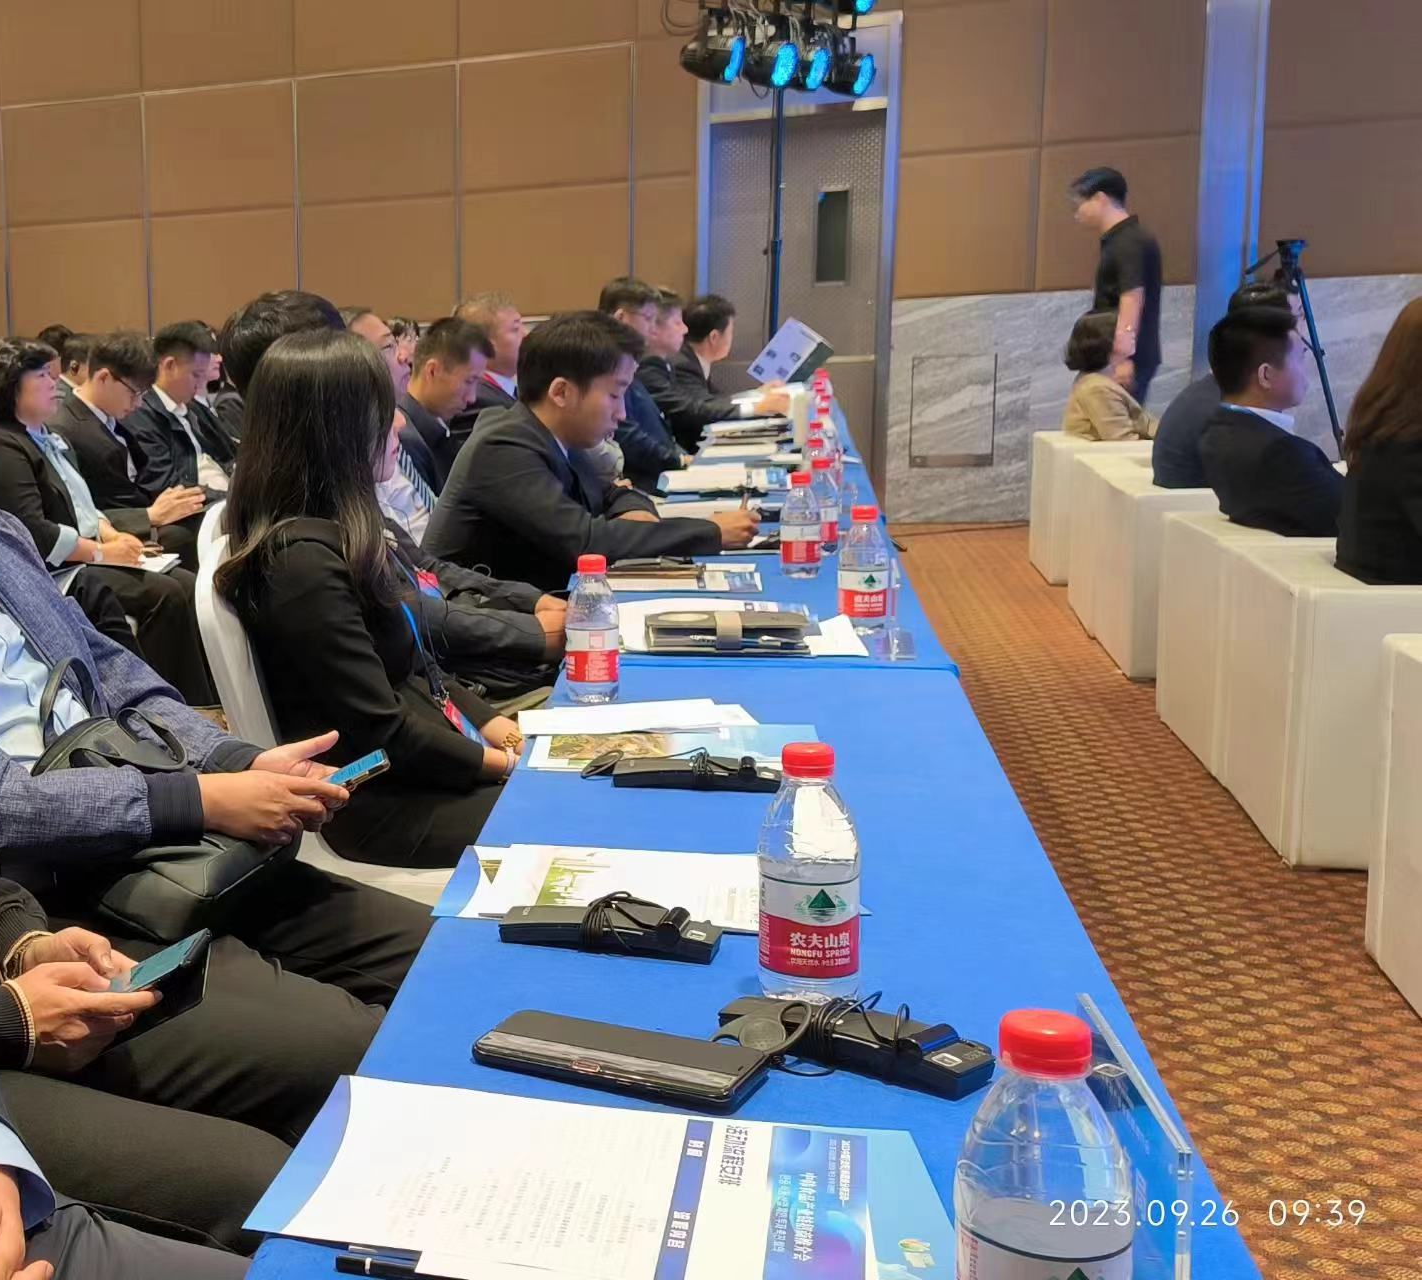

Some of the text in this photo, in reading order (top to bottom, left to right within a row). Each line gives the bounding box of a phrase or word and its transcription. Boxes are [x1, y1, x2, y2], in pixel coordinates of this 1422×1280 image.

[789, 931, 850, 949] 农夫山泉
[790, 946, 851, 958] NONGFU SPRING
[718, 1124, 749, 1186] 活动流程安排
